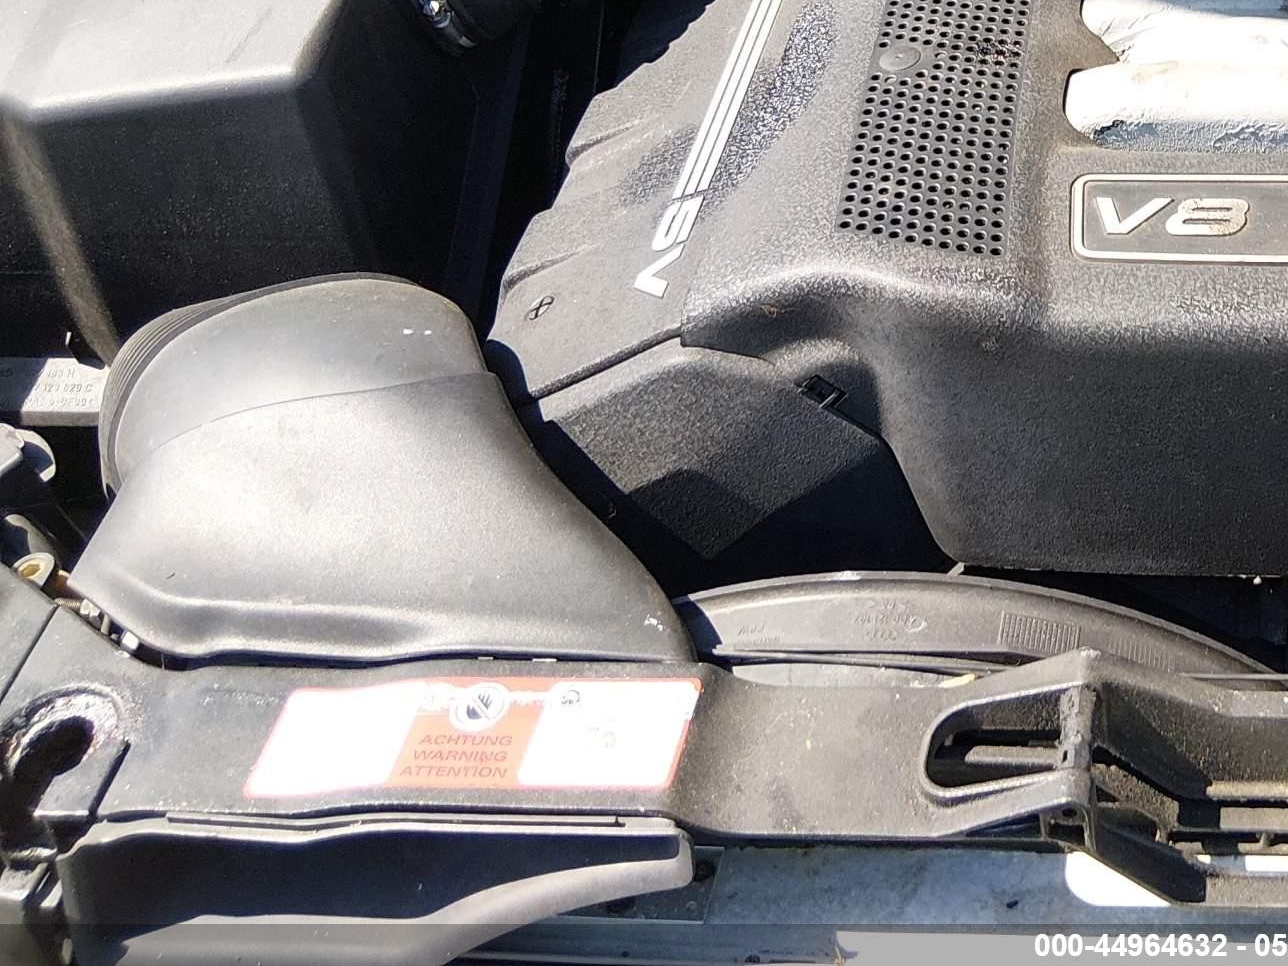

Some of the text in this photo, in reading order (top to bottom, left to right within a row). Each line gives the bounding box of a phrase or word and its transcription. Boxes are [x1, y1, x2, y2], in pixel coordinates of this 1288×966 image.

[1096, 196, 1250, 236] V8
[419, 734, 513, 746] ACHTUNG
[414, 749, 508, 763] WARNING
[399, 765, 508, 779] ATTENTION
